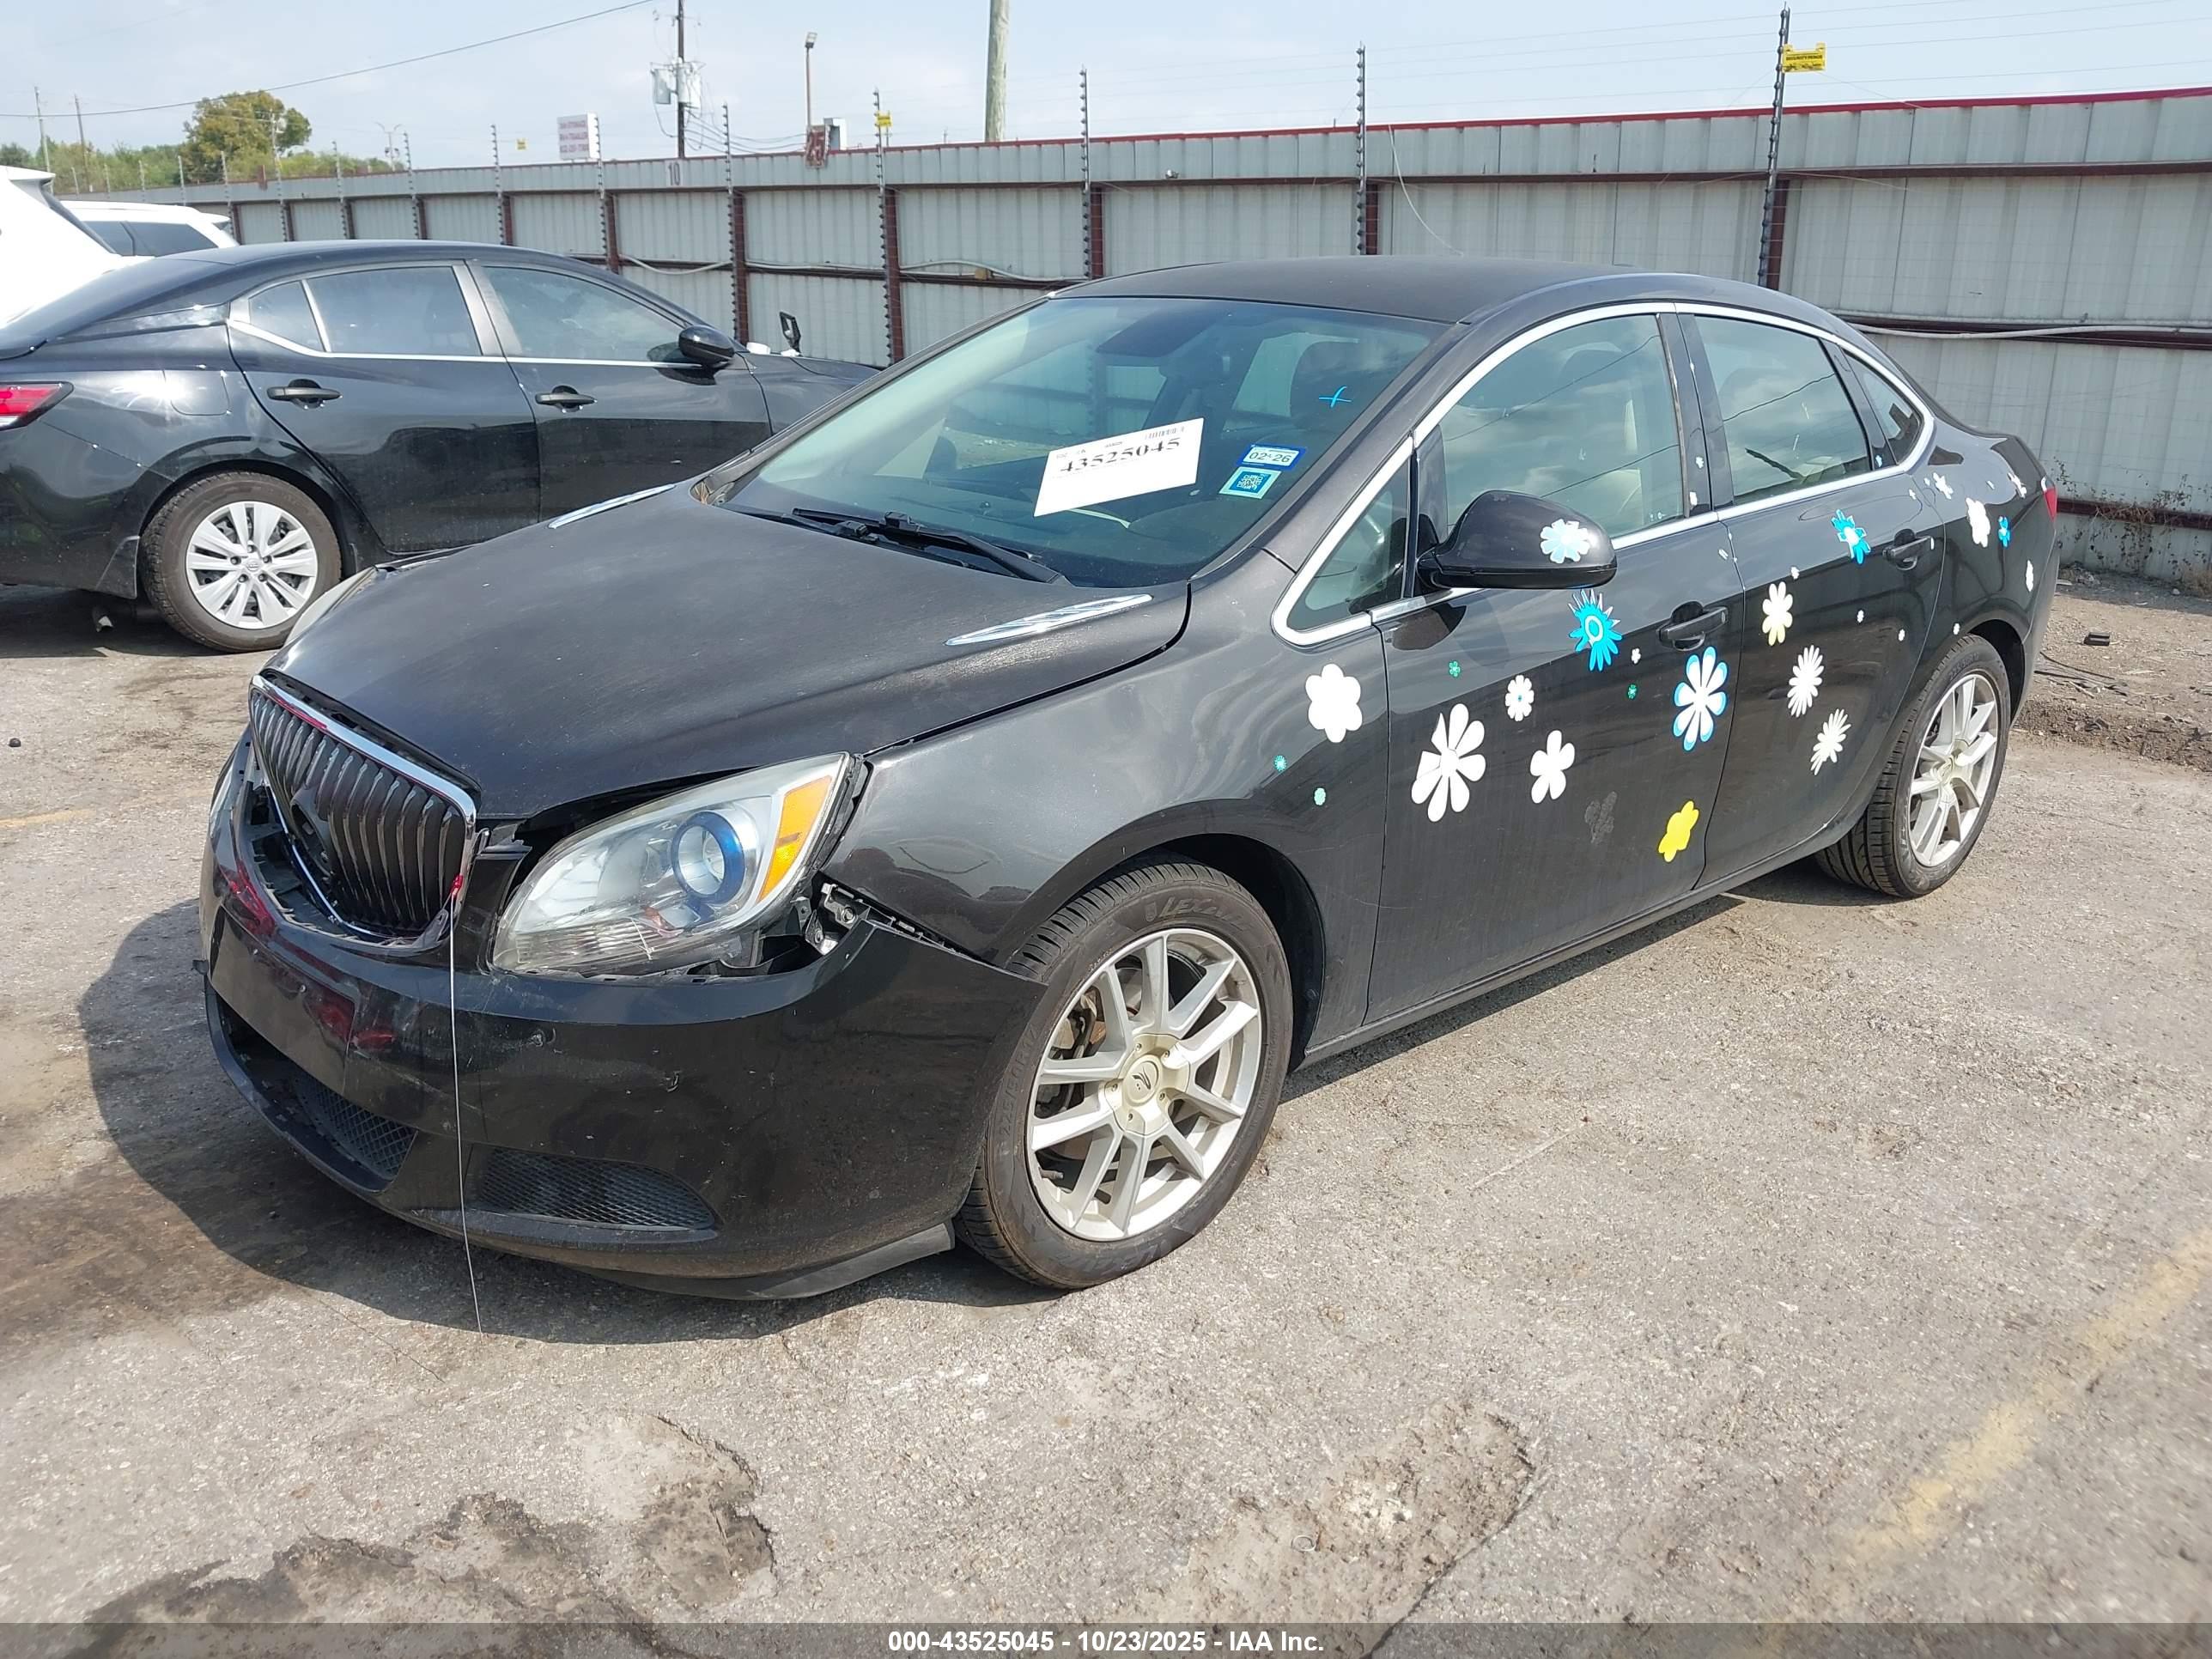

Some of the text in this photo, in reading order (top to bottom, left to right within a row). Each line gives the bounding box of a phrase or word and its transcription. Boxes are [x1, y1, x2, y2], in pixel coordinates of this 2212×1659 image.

[668, 161, 681, 186] 10
[1060, 437, 1181, 472] 43525045
[1249, 452, 1292, 463] 02 26
